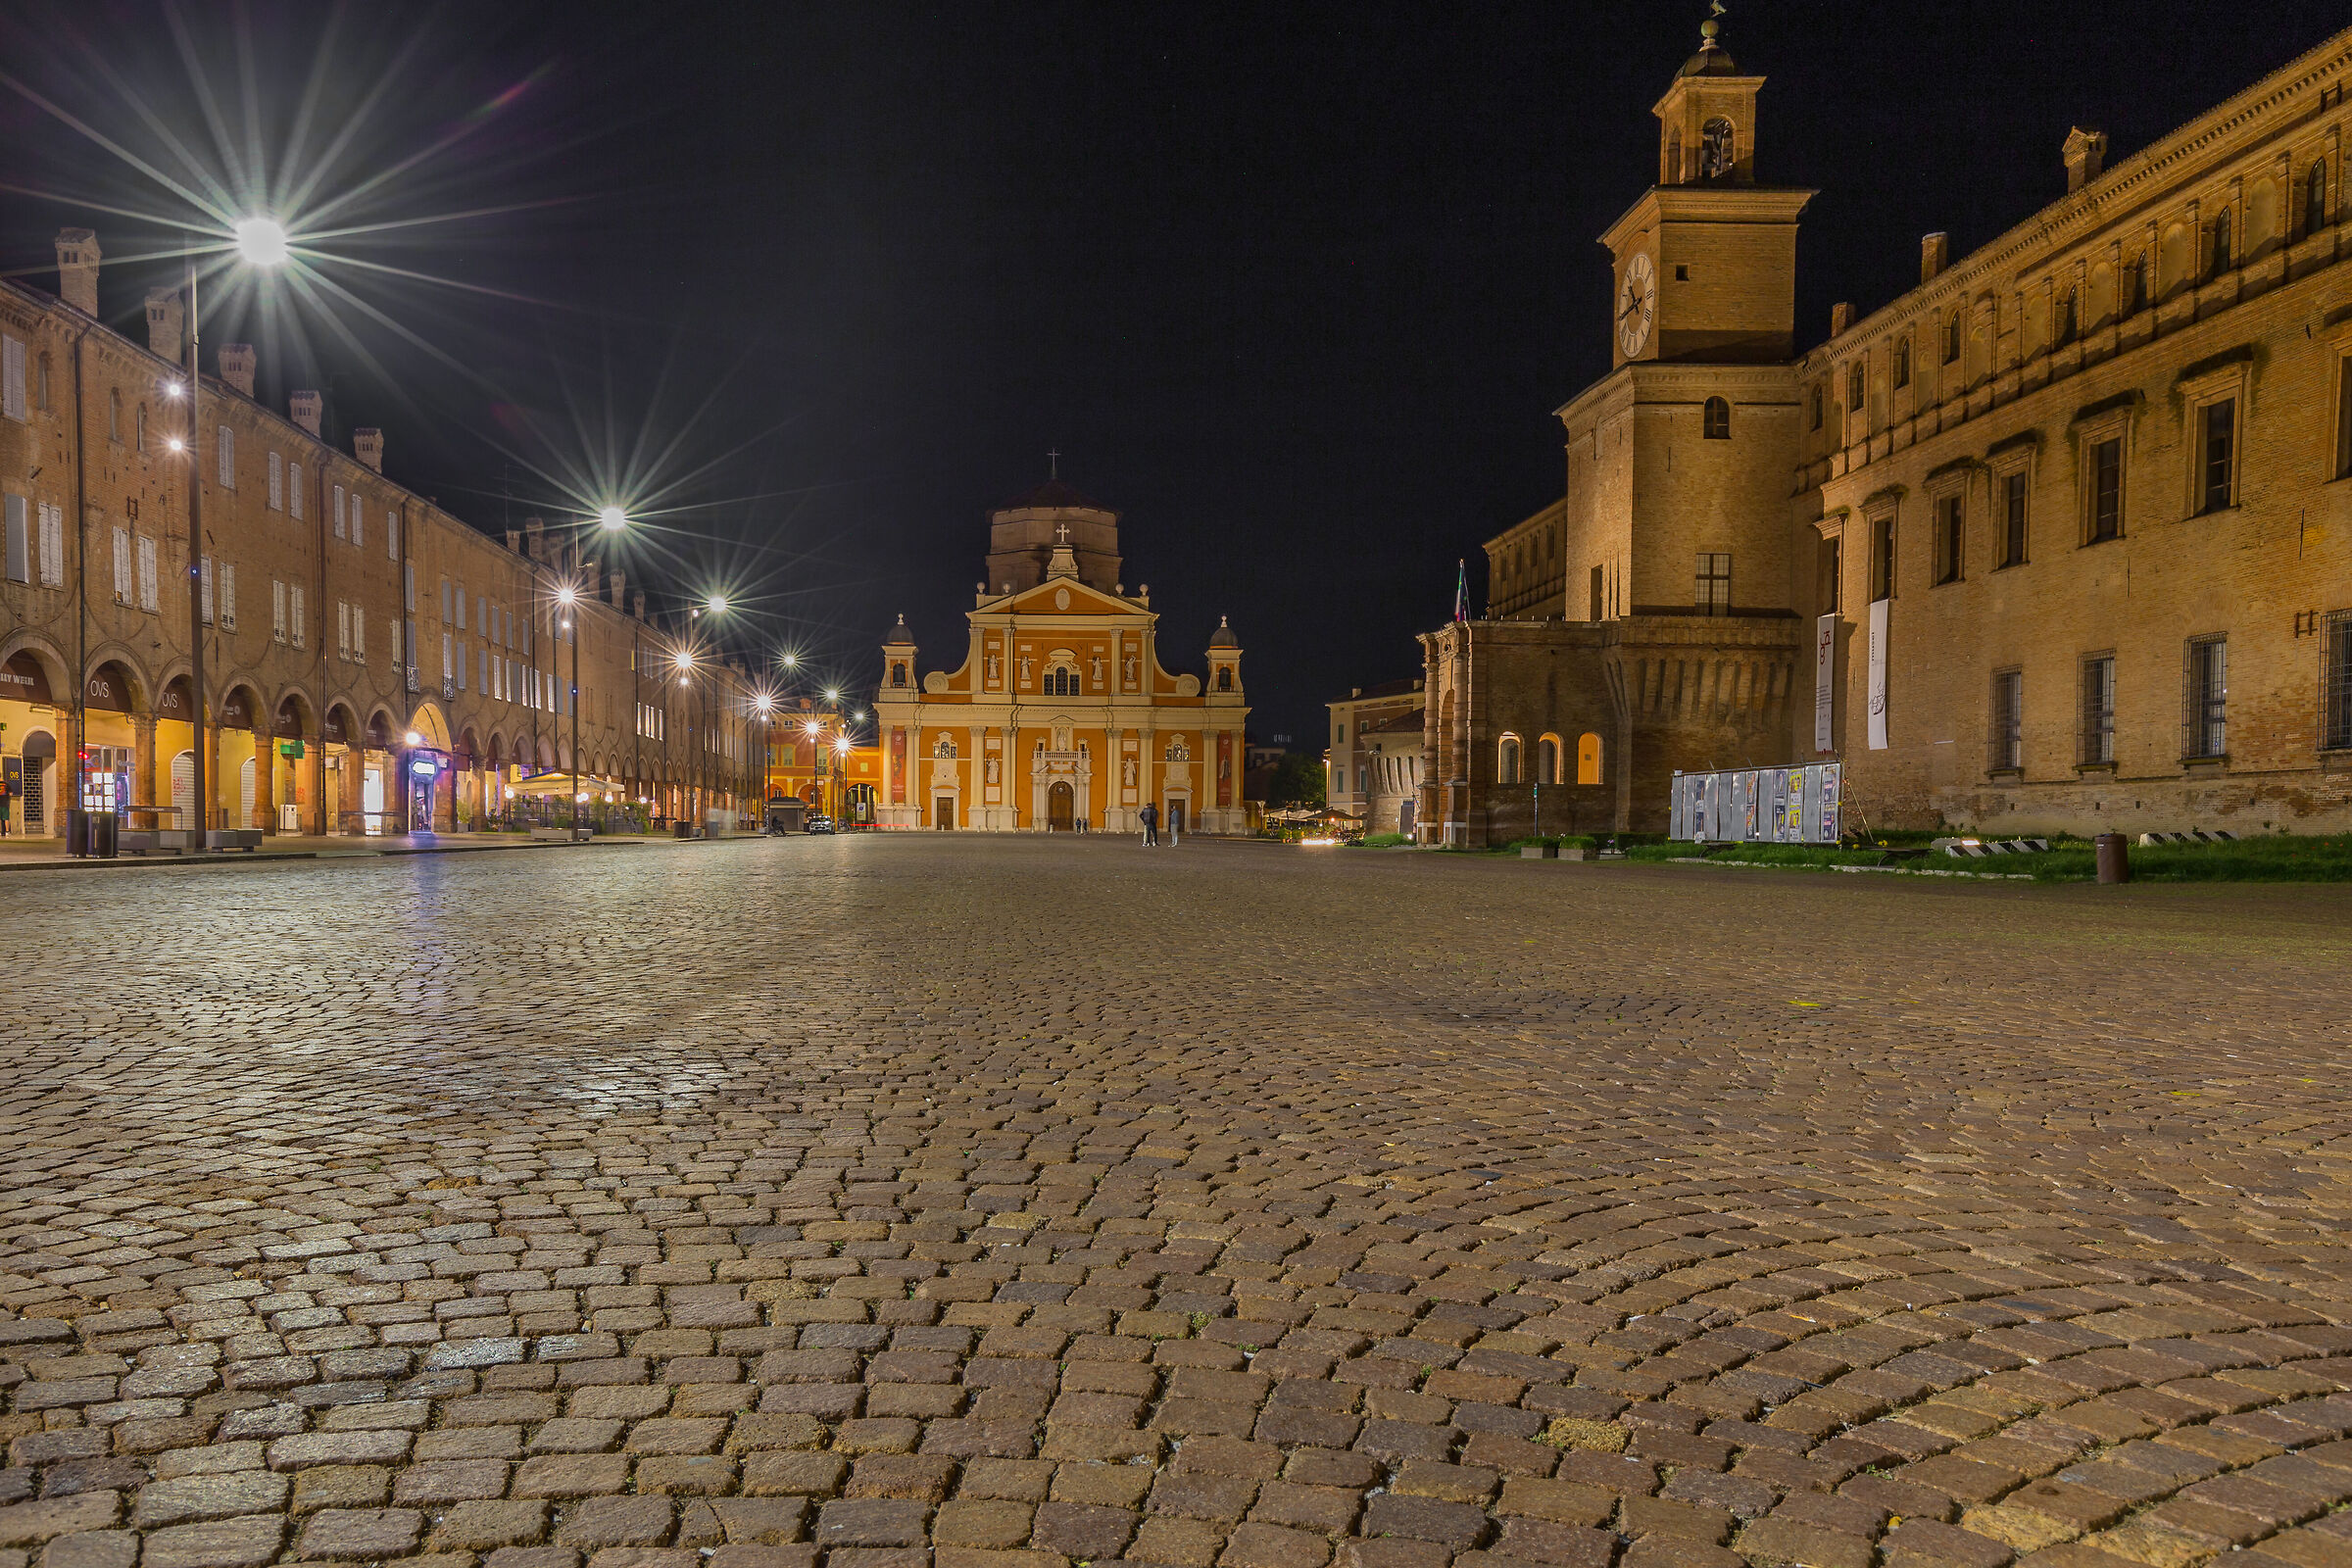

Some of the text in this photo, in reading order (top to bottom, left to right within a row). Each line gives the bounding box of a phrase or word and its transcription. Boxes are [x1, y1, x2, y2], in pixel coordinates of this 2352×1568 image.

[90, 680, 109, 699] OVS
[162, 692, 178, 709] OVS
[10, 770, 20, 779] OVS
